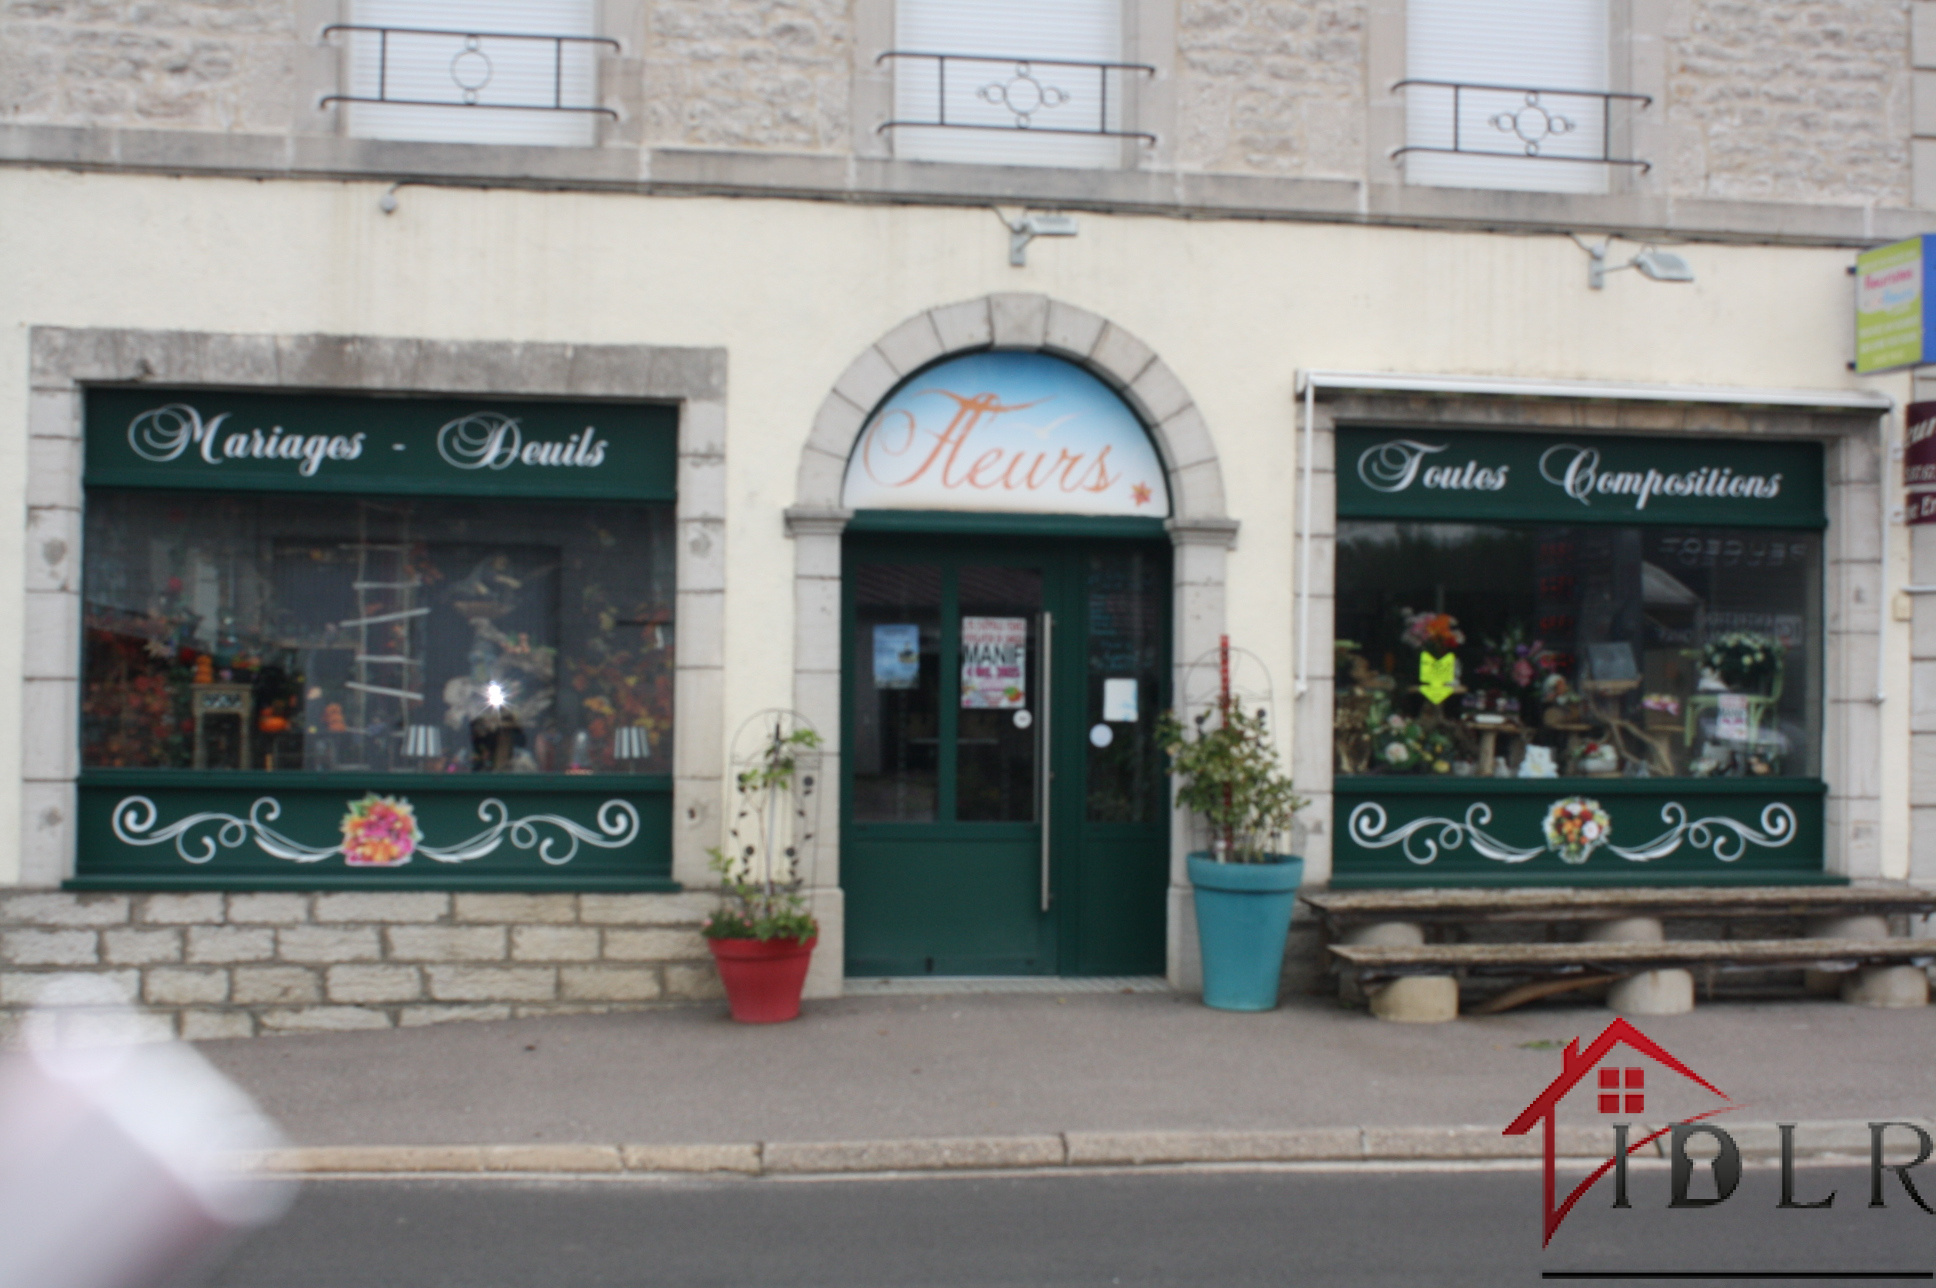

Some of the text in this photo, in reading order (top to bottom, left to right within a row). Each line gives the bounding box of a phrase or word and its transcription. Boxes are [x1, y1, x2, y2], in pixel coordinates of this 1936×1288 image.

[127, 402, 367, 477] Mariages
[437, 410, 608, 470] Deuils
[863, 387, 1124, 492] Fleurs
[1357, 438, 1783, 510] Toutes Compositions
